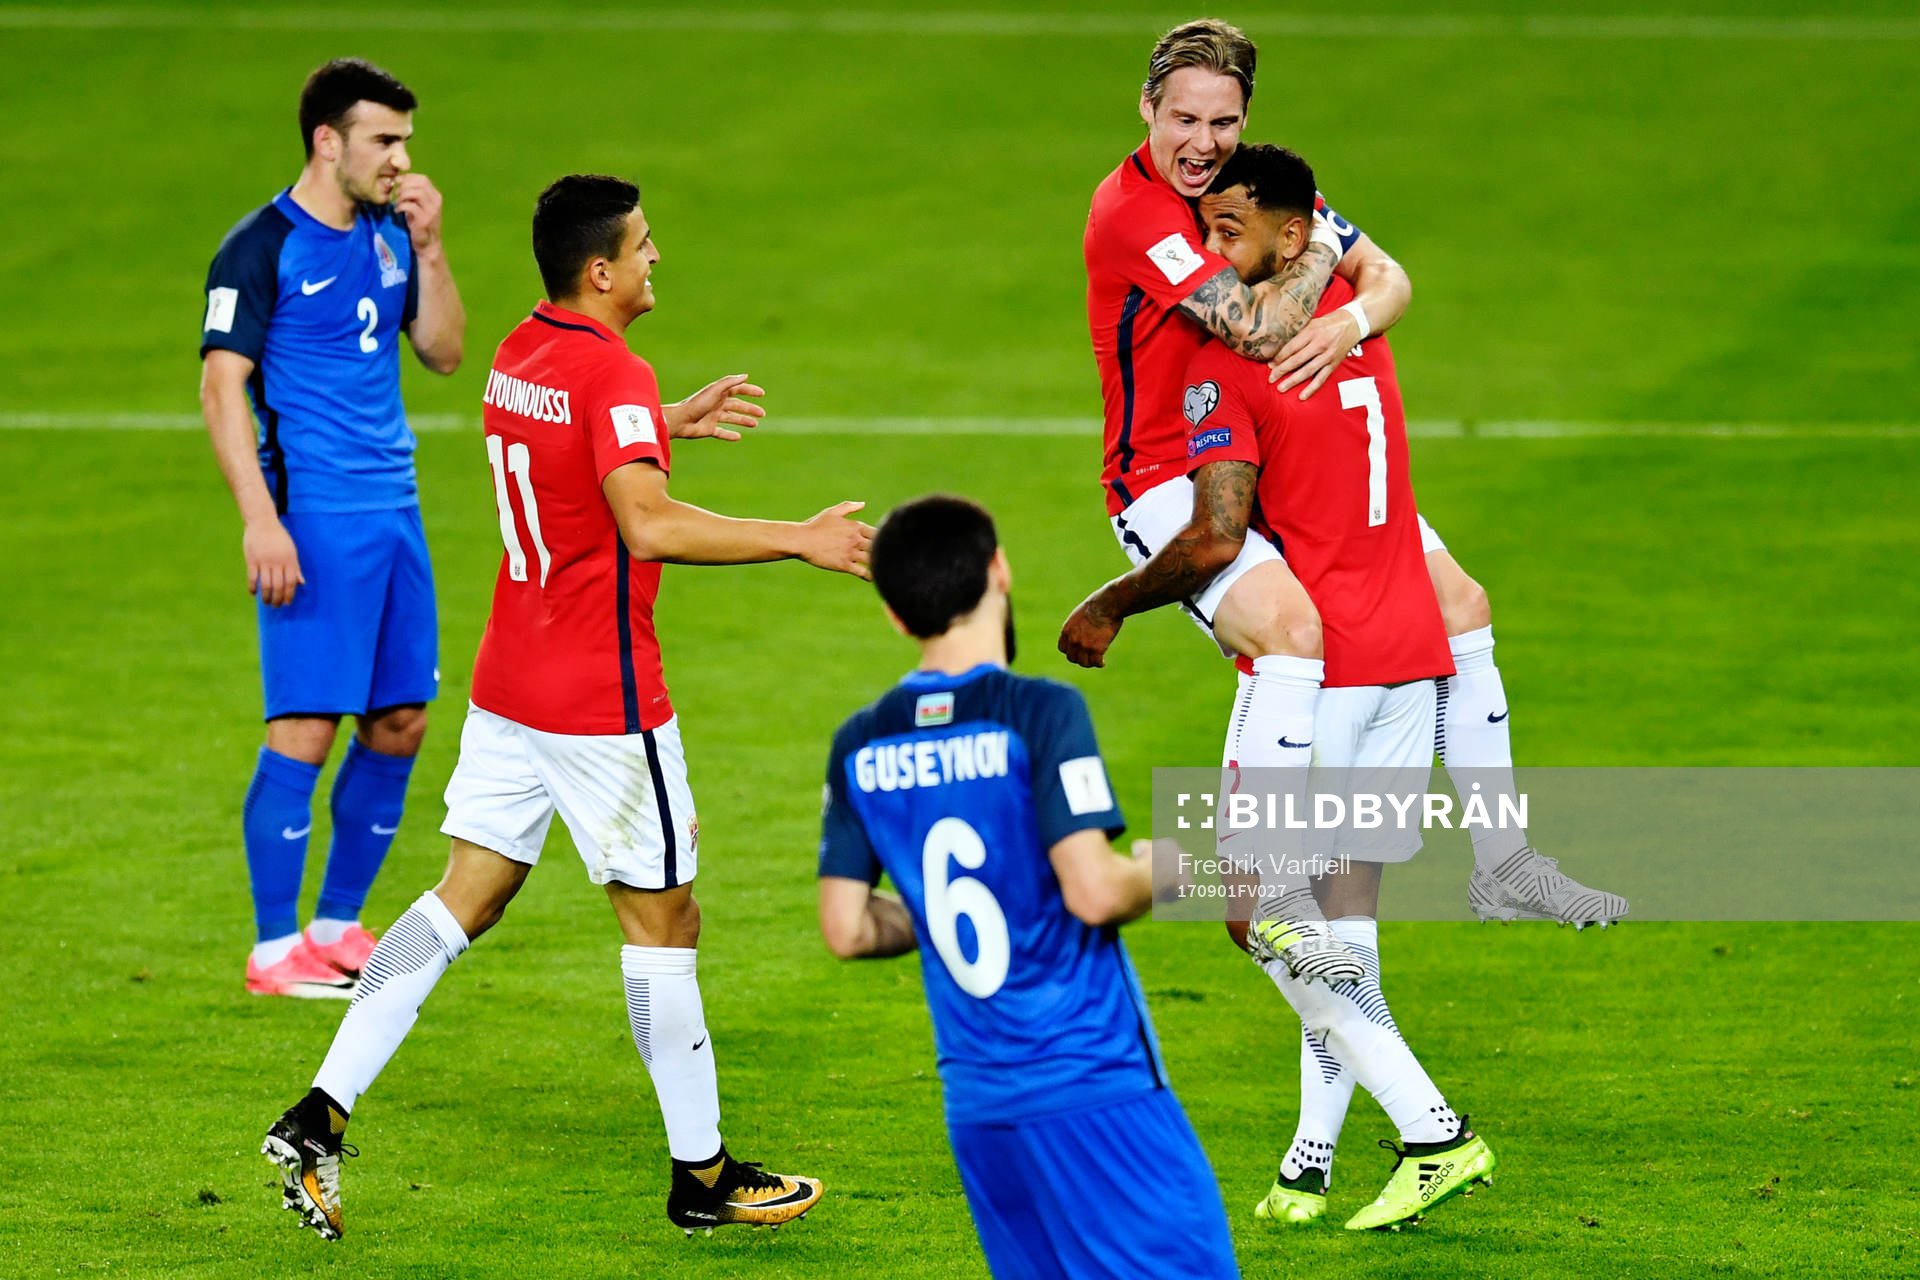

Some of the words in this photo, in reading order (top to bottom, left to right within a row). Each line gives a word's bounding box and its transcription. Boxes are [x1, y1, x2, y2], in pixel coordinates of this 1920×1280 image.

[356, 296, 379, 354] 2
[1195, 432, 1231, 449] RESPECT
[1338, 376, 1388, 528] 7
[485, 433, 552, 589] 11
[922, 816, 1011, 1000] 6
[1421, 1161, 1455, 1203] adidas
